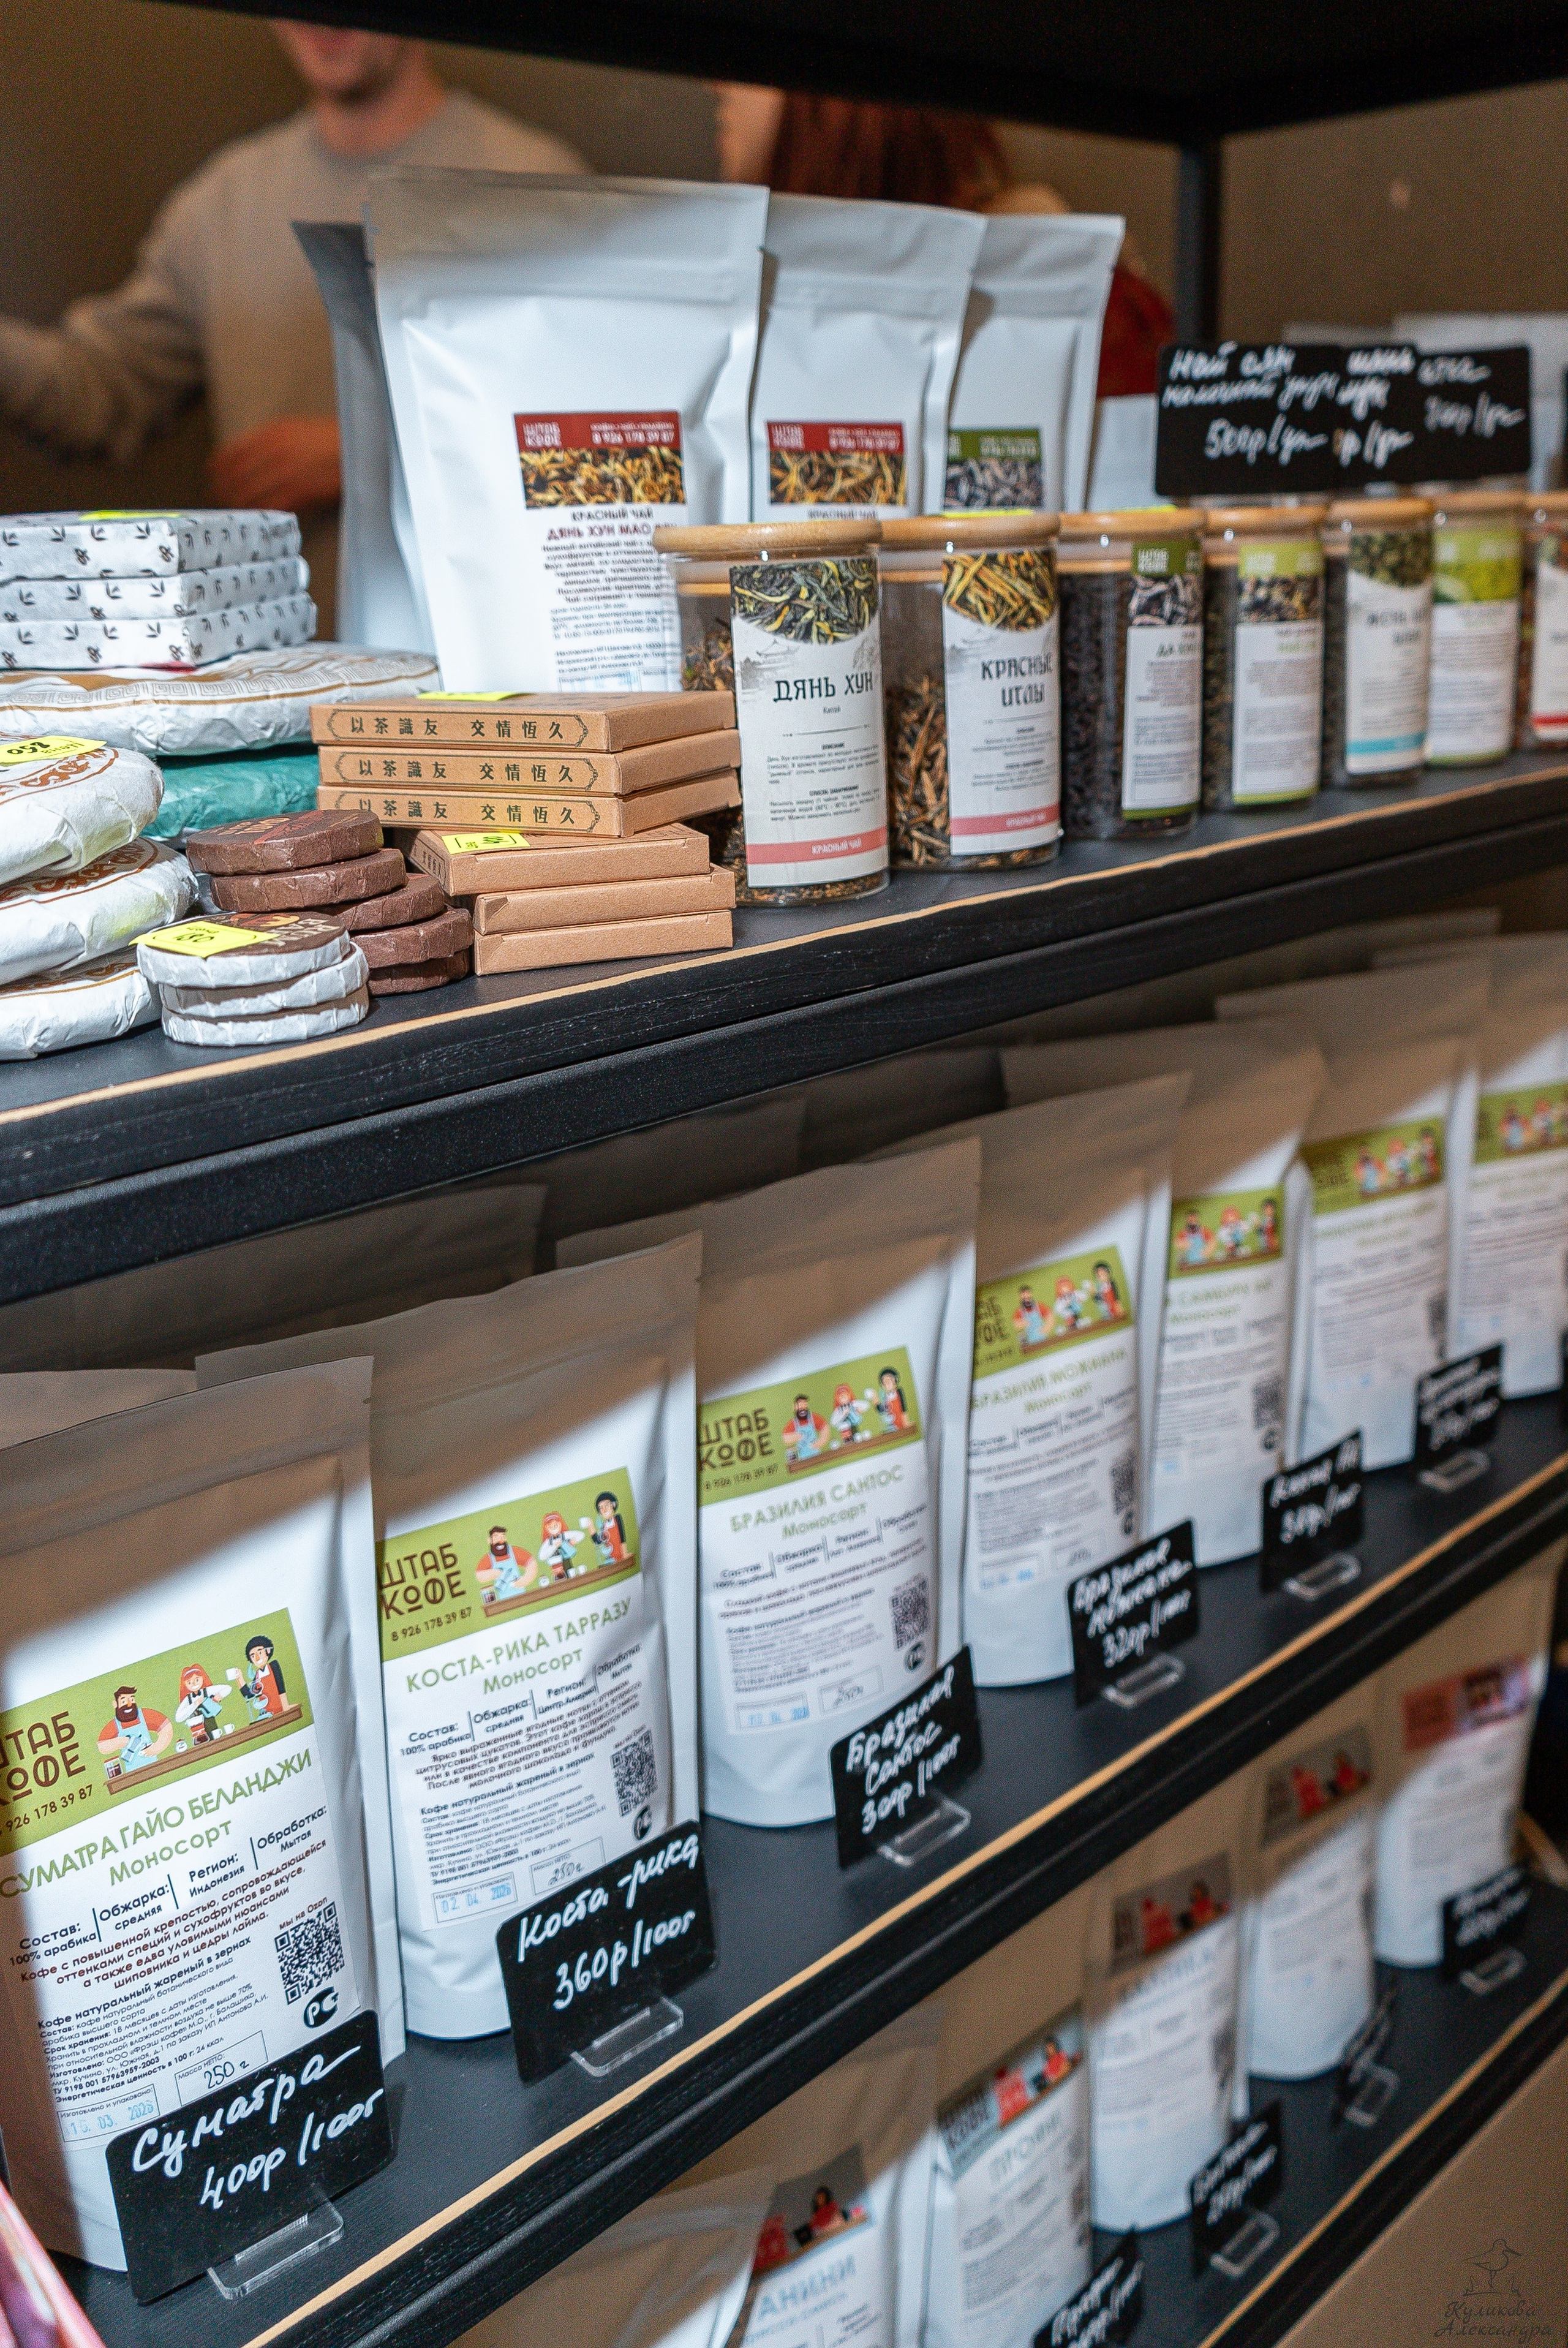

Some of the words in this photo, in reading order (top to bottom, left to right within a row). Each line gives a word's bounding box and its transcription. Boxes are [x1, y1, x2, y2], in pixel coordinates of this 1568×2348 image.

[547, 526, 584, 541] ДЯНЬ
[773, 678, 836, 703] ДЯНЬ
[844, 671, 874, 695] ХУН
[1001, 683, 1045, 707] ИГЛЫ
[812, 841, 848, 855] КРАСНЫЙ
[731, 1490, 826, 1533] БРАЗИЛИЯ
[382, 1543, 458, 1588] ШТАБ
[381, 1571, 466, 1620] КОФЕ
[402, 1625, 421, 1639] 926
[424, 1617, 443, 1631] 178
[407, 1631, 549, 1693] КОСТА-РИКА
[554, 1596, 632, 1642] ТАРРАЗУ
[483, 1648, 582, 1694] Моносорт
[0, 1711, 76, 1768] ТАБ
[0, 1743, 86, 1806] ОФЕ
[0, 1835, 119, 1898] СУМАТРА
[119, 1807, 184, 1849] ГАЙО
[187, 1748, 312, 1820] БЕЛАНДЖИ
[6, 1814, 30, 1834] 926
[34, 1801, 58, 1819] 178
[61, 1793, 74, 1808] 39
[78, 1784, 93, 1800] 87
[19, 1923, 81, 1950] Состав:
[99, 1884, 169, 1921] Обжарка:
[187, 1854, 239, 1882] Регион:
[257, 1806, 327, 1849] Обработка:
[110, 1819, 232, 1886] Моносорт
[9, 1950, 41, 1966] 100%
[43, 1933, 96, 1957] арабика
[114, 1905, 163, 1930] средняя
[188, 1866, 245, 1897] Индонезия
[280, 1830, 312, 1852] Мытая
[20, 1966, 58, 1982] Кофе
[72, 1928, 150, 1966] повышенной
[154, 1900, 219, 1933] крепостью,
[221, 1840, 326, 1901] сопровождающейся
[56, 1954, 124, 1984] оттенками
[127, 1931, 171, 1957] специй
[183, 1892, 257, 1932] сухофруктов
[259, 1884, 271, 1895] во
[274, 1867, 306, 1887] вкусе,
[96, 1965, 133, 1983] также
[136, 1949, 165, 1966] едва
[167, 1917, 232, 1955] уловимыми
[235, 1886, 289, 1922] нюансами
[114, 1955, 179, 1989] шиповника
[193, 1931, 230, 1955] цедры
[232, 1912, 269, 1935] лайма.
[38, 2016, 72, 2032] Кофе
[75, 1983, 151, 2020] натуральный
[154, 1958, 204, 1989] жареный
[215, 1937, 251, 1960] зернах
[39, 2026, 74, 2040] Состав:
[76, 2017, 100, 2029] кофе
[102, 1994, 154, 2020] натуральный
[157, 1967, 214, 1998] ботанического
[215, 1957, 233, 1969] вида
[42, 2033, 80, 2050] арабика
[81, 2020, 119, 2036] высшего
[120, 2009, 146, 2022] сорта
[43, 2046, 66, 2058] Срок
[68, 2032, 111, 2049] хранения:
[124, 2012, 160, 2030] месяцев
[168, 1999, 187, 2012] даты
[66, 2042, 128, 2067] относительной
[130, 2024, 172, 2046] влажности
[88, 2029, 141, 2052] прохладном
[183, 1998, 207, 2013] месте
[50, 2061, 104, 2082] Изготовлено:
[106, 2052, 128, 2063] ООО
[55, 2081, 125, 2106] Энергетическая
[127, 2065, 166, 2083] ценность
[64, 2083, 83, 2092] 9198
[85, 2079, 98, 2088] 001
[204, 2061, 235, 2089] 250
[133, 2045, 361, 2178] Суматра
